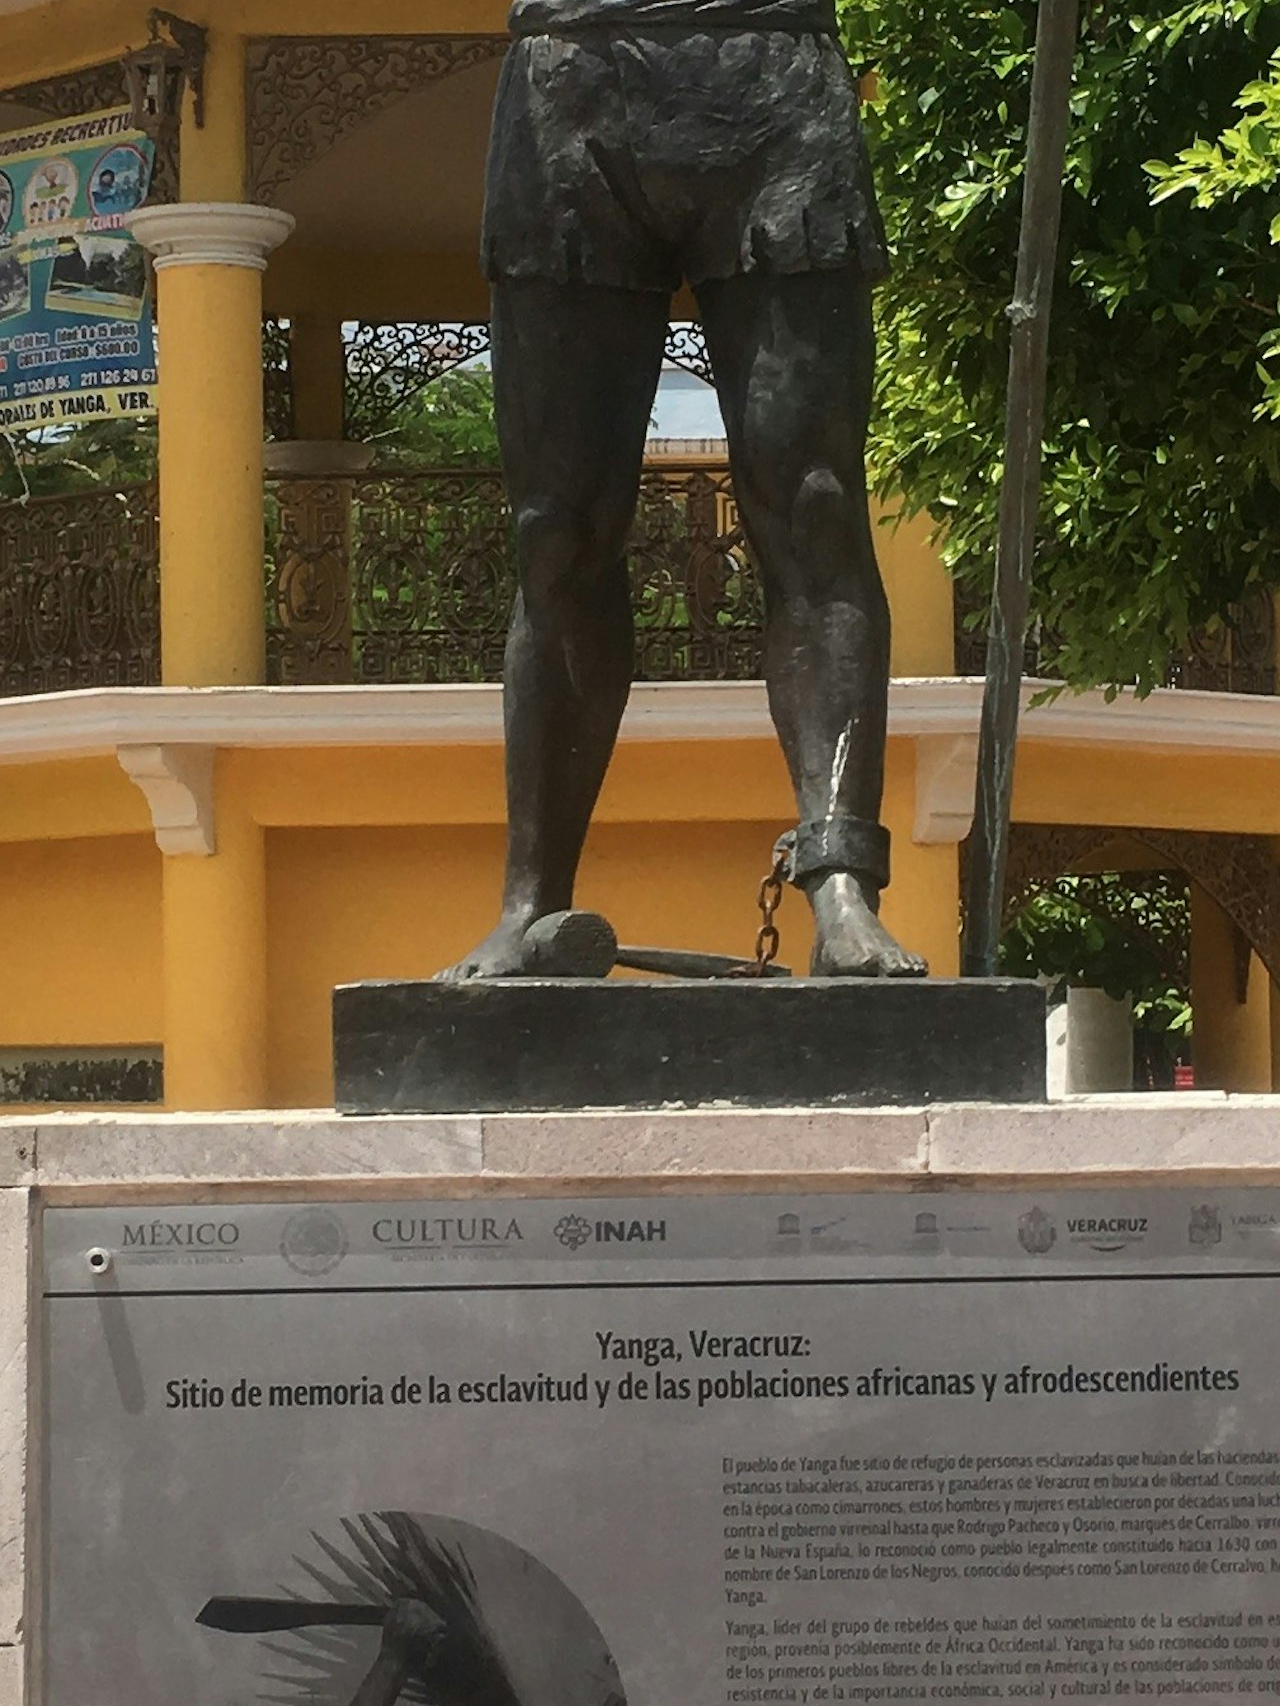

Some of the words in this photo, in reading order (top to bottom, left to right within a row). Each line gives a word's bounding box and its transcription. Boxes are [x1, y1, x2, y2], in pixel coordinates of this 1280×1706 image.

[40, 399, 55, 419] DE
[58, 394, 110, 415] YANGA,
[117, 391, 155, 411] VER.
[121, 1218, 240, 1247] MÉXICO
[371, 1218, 525, 1243] CULTURA
[595, 1220, 667, 1243] INAH
[1066, 1217, 1150, 1234] VERACRUZ
[595, 1330, 682, 1367] Yanga,
[689, 1329, 810, 1358] Veracruz:
[166, 1377, 224, 1408] Sitio
[230, 1377, 262, 1407] de
[268, 1377, 383, 1406] memoria
[390, 1375, 421, 1404] de
[428, 1374, 451, 1404] la
[457, 1371, 588, 1403] esclavitud
[594, 1380, 610, 1408] y
[617, 1371, 648, 1400] de
[655, 1370, 690, 1400] las
[697, 1367, 849, 1407] poblaciones
[856, 1365, 975, 1397] africanas
[981, 1373, 997, 1402] y
[1004, 1361, 1239, 1394] afrodescendientes
[726, 1684, 797, 1702] resistencia
[800, 1688, 808, 1704] y
[812, 1684, 829, 1700] de
[832, 1683, 844, 1700] la
[848, 1685, 926, 1703] importancia
[930, 1680, 1003, 1699] económica,
[1007, 1680, 1044, 1697] social
[1048, 1683, 1057, 1700] y
[1060, 1679, 1111, 1695] cultural
[1114, 1678, 1130, 1695] de
[1134, 1678, 1153, 1694] las
[1156, 1677, 1233, 1697] poblaciones
[1237, 1677, 1253, 1693] de
